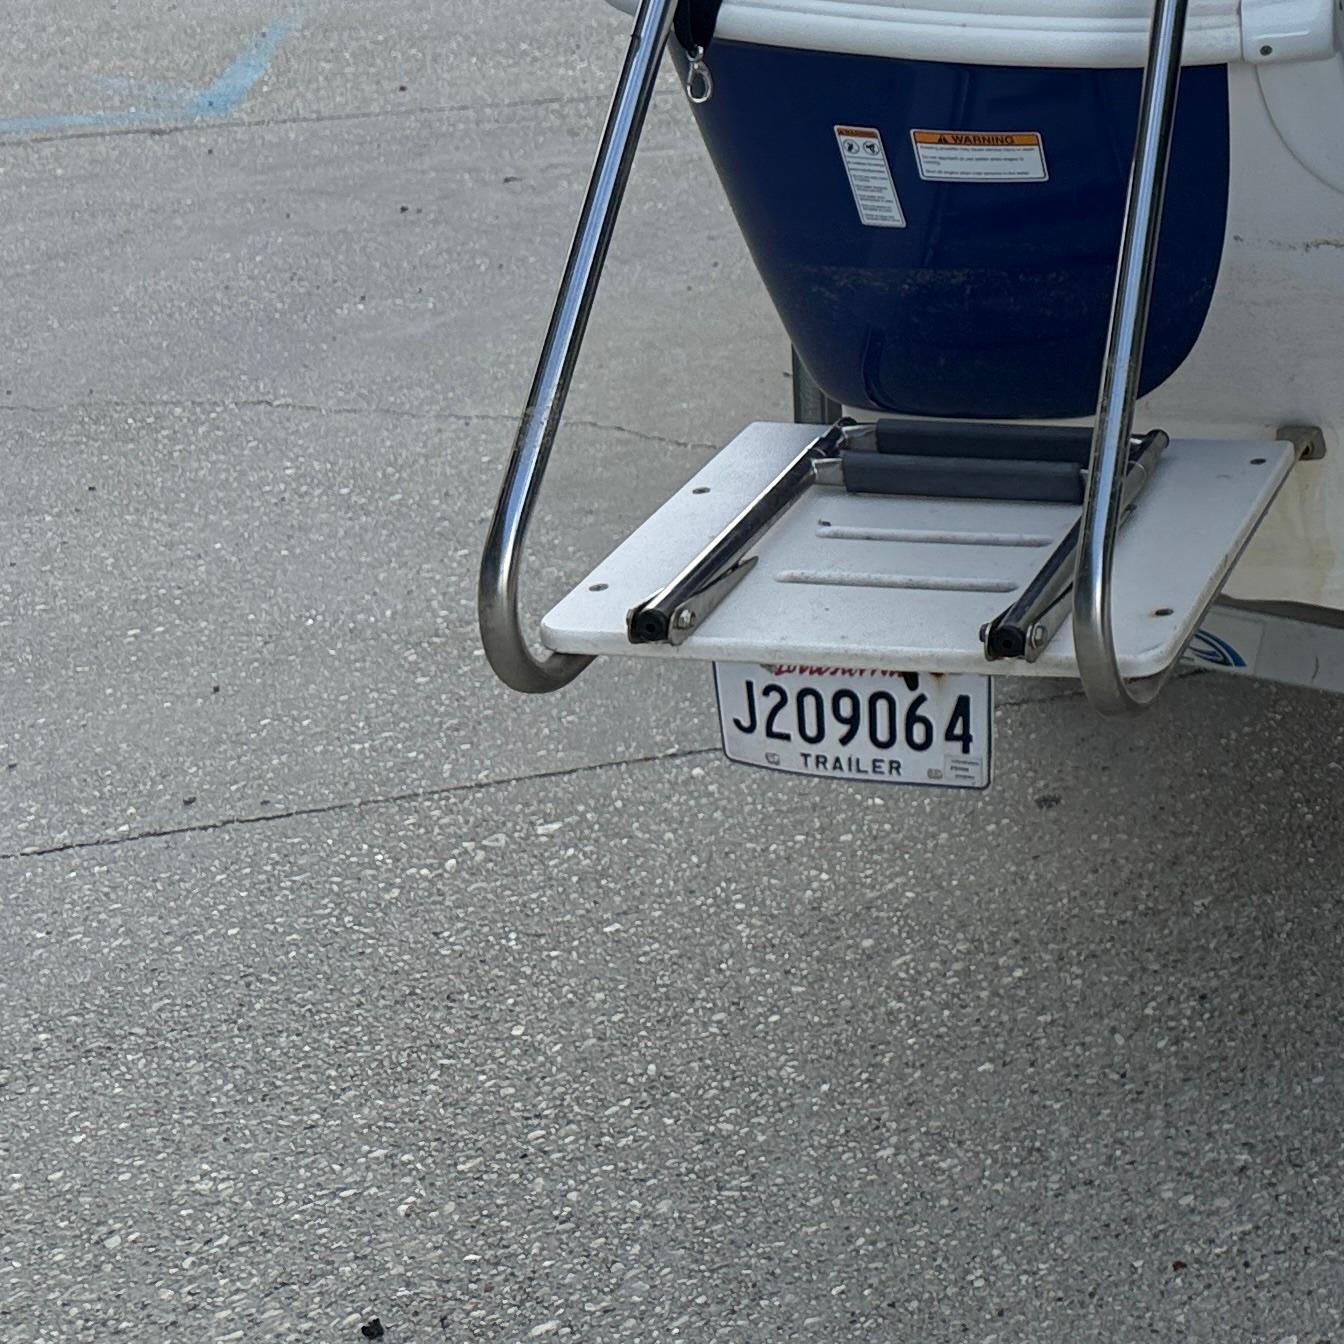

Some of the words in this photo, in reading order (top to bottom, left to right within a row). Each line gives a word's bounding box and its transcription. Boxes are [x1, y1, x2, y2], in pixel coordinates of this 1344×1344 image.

[952, 135, 1016, 145] WARNING
[732, 679, 974, 755] J209064
[799, 752, 902, 777] TRAILER
